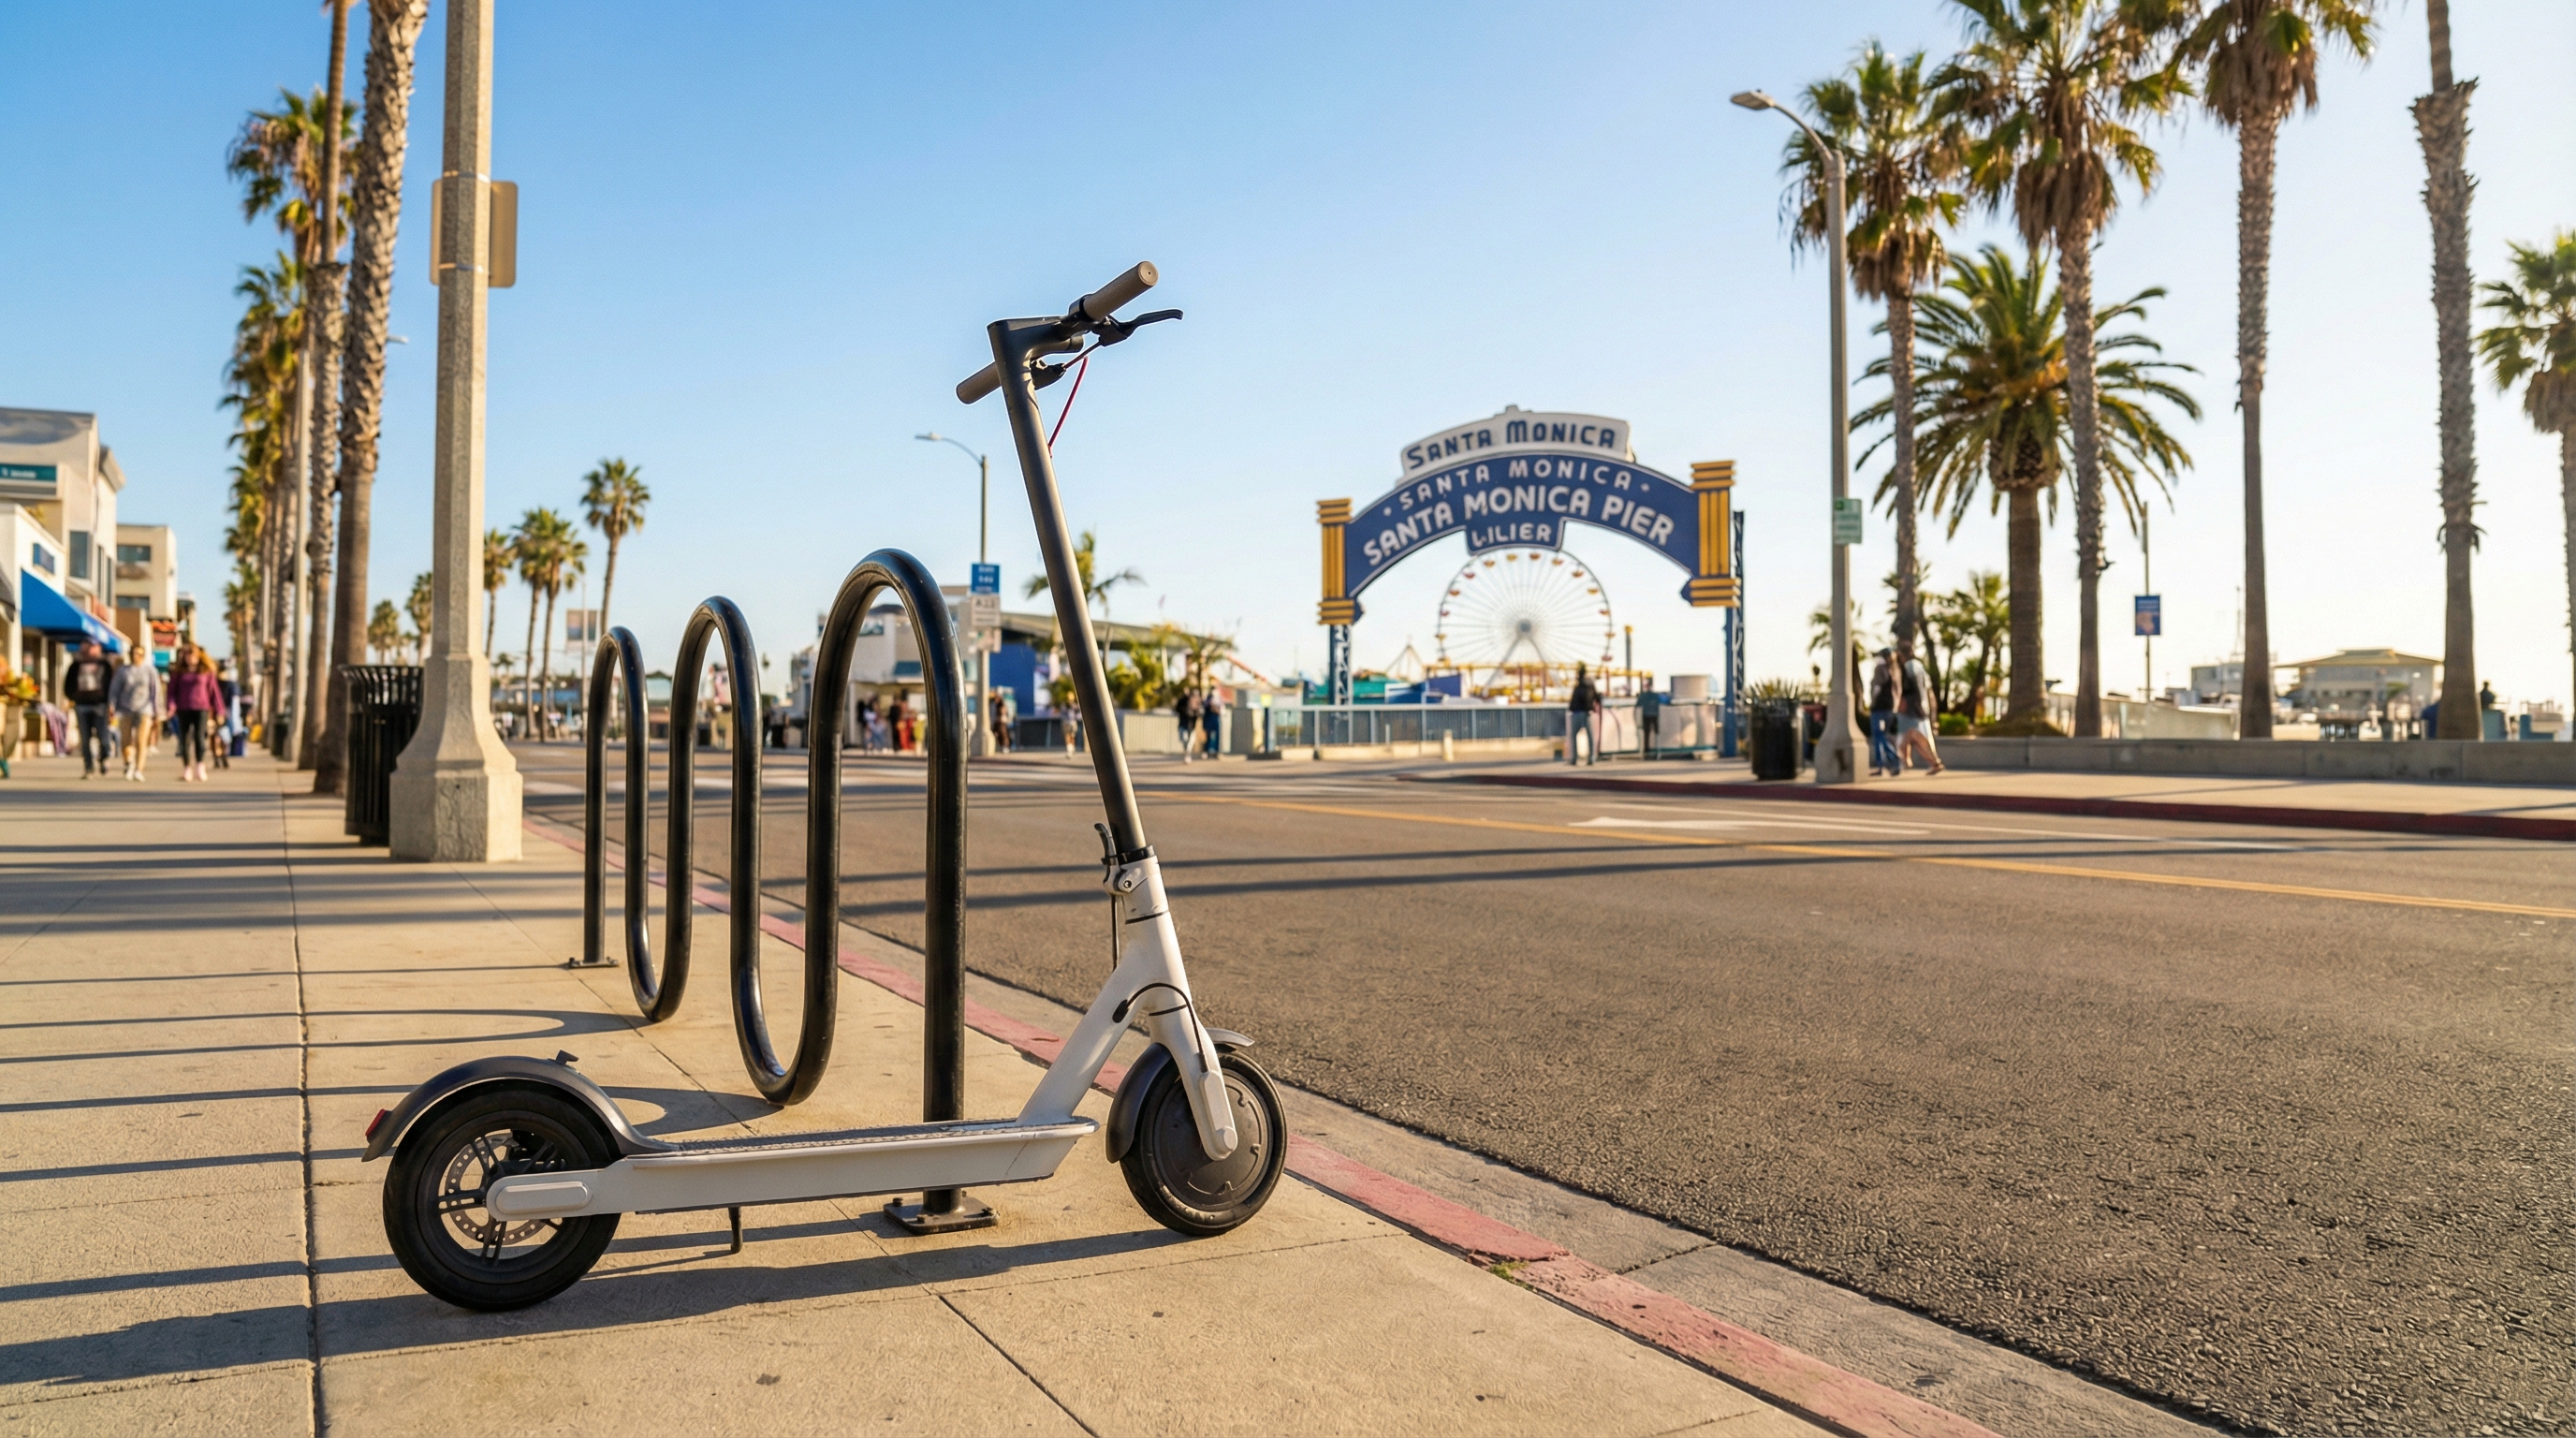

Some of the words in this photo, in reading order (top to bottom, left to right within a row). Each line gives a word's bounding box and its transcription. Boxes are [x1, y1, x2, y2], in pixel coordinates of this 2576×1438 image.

[1406, 429, 1493, 470] SANTA
[1505, 418, 1616, 449] MONICA
[1398, 463, 1490, 511] SANTA
[1508, 458, 1632, 492] MONICA
[1363, 501, 1455, 566] SANTA
[1463, 484, 1591, 521] MONICA
[1600, 493, 1676, 547] PIER
